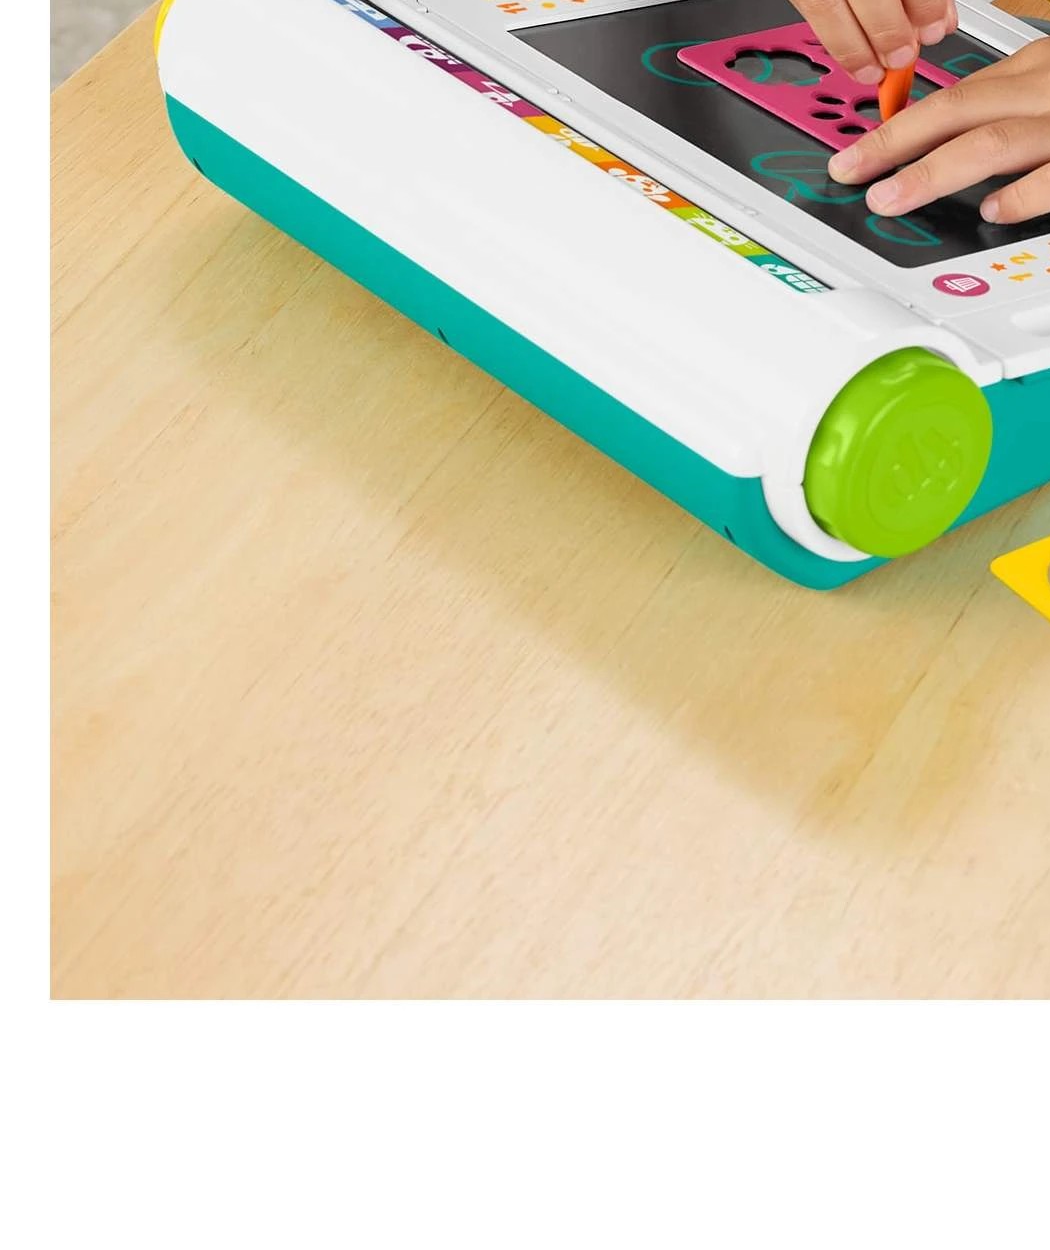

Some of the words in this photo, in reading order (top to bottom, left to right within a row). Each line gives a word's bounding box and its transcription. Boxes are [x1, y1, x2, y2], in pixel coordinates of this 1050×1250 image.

[496, 2, 528, 15] 11
[1009, 252, 1038, 266] 2
[1008, 272, 1033, 282] 1
